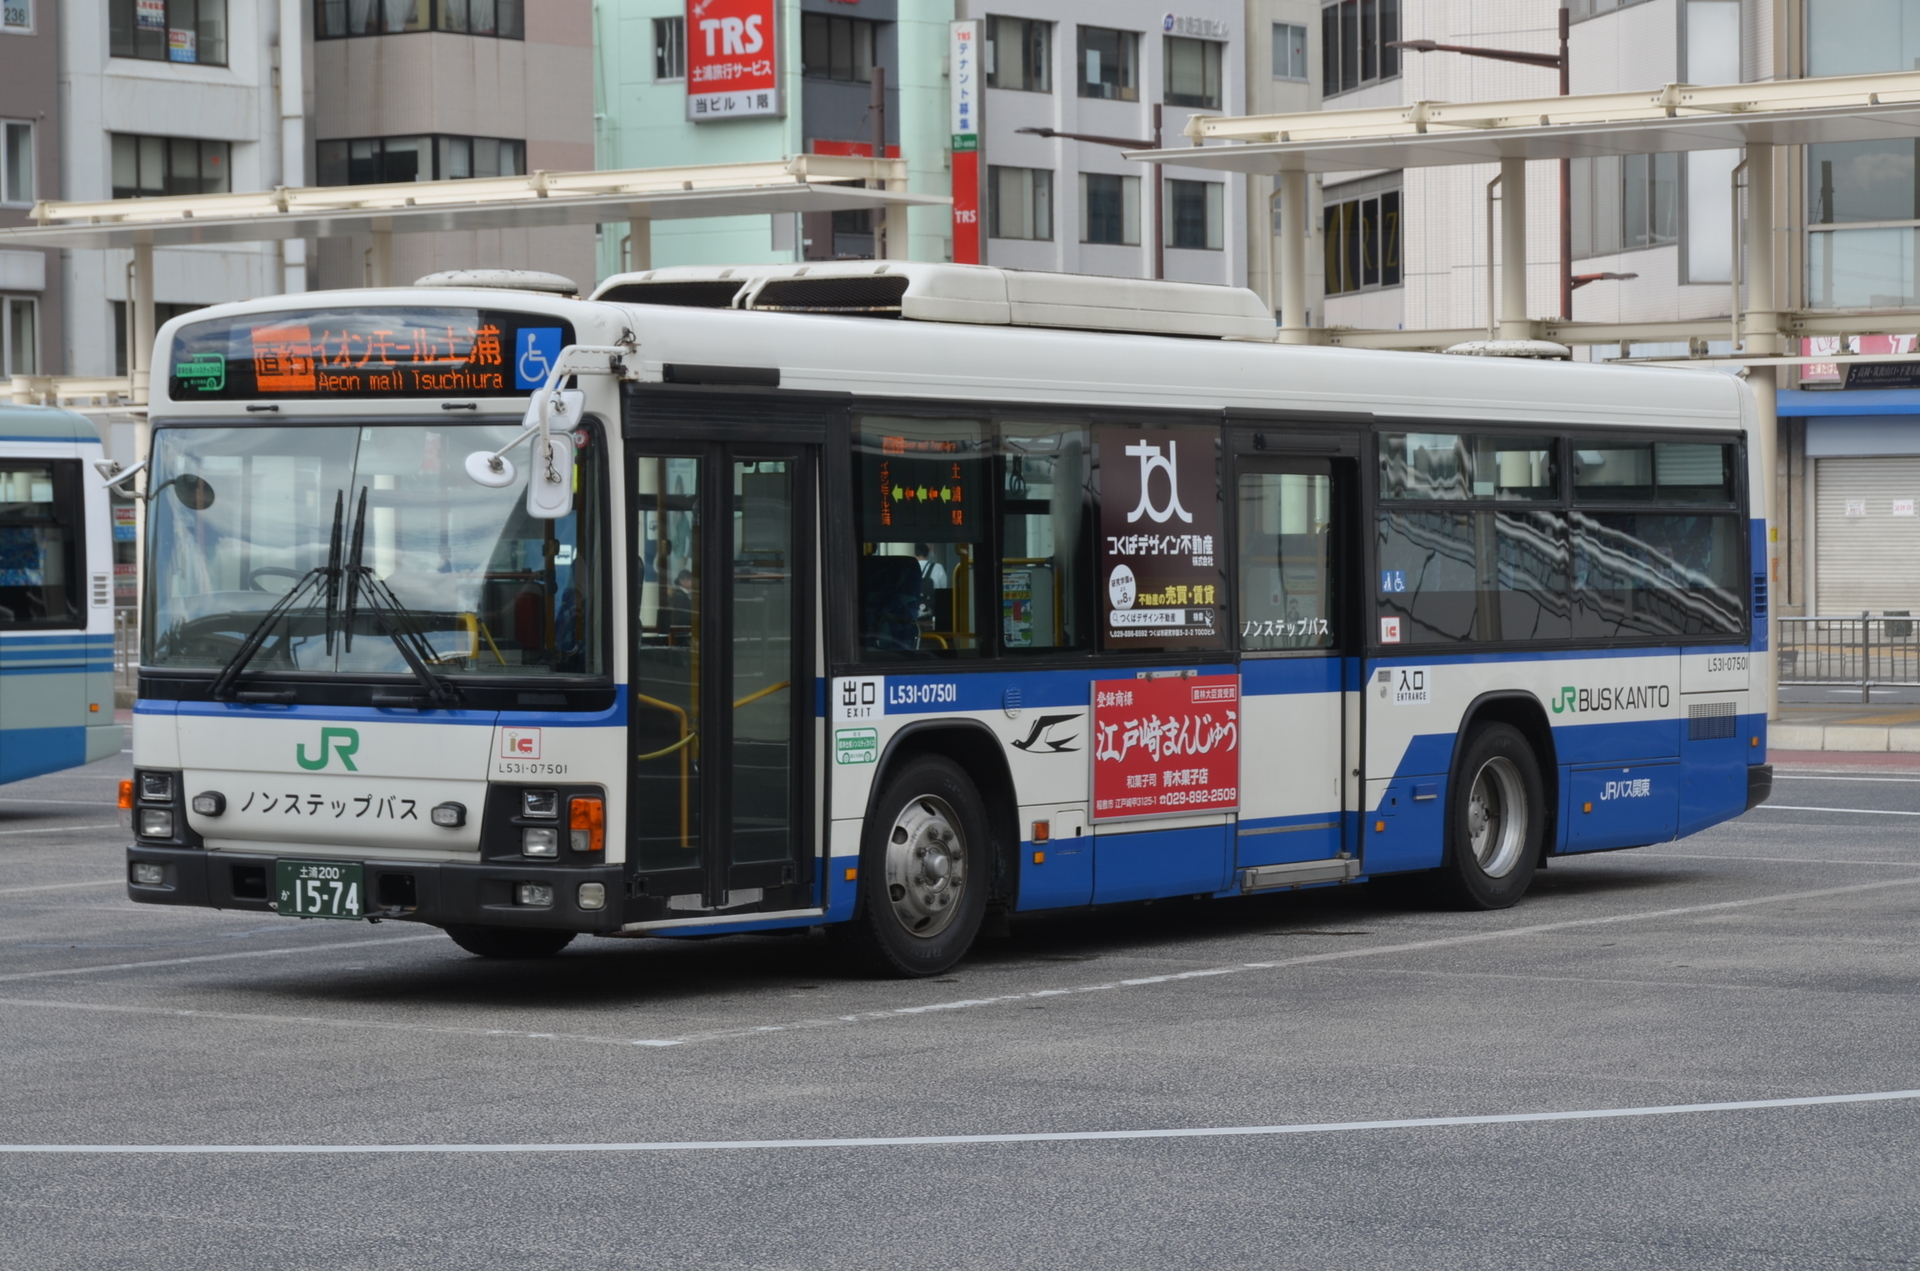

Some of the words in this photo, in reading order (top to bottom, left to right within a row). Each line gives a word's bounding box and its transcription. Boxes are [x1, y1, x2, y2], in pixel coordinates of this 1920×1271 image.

[5, 7, 25, 22] 236
[699, 14, 764, 57] TRS
[956, 31, 972, 41] TRS
[692, 60, 772, 82] 土浦旅行サービス
[959, 42, 970, 130] テナント募集
[696, 97, 735, 113] 当ビル
[746, 94, 769, 109] 1階
[955, 209, 976, 223] TRS
[313, 324, 502, 367] イオンモール土浦
[252, 338, 313, 378] 直行
[318, 372, 361, 392] Aeon
[369, 371, 404, 391] mall
[411, 370, 504, 391] Tsuchiura
[952, 462, 963, 525] 土浦駅
[1106, 534, 1214, 556] つくばデザイン不動産
[1192, 556, 1214, 567] 株式会社
[1119, 612, 1177, 623] つくばデザイン不動産
[1242, 617, 1329, 637] ノンステップバス
[1707, 656, 1748, 673] L531-07501
[1400, 670, 1424, 691] 入口
[843, 680, 876, 706] 出口
[889, 683, 957, 705] L531-07501
[1096, 690, 1134, 708] 登録商標
[1193, 688, 1236, 701] 農林大臣賞受賞
[1397, 692, 1427, 701] ENTRANCE
[1552, 686, 1577, 714] JR
[847, 707, 872, 718] EXIT
[296, 727, 360, 771] JR
[499, 762, 568, 775] L531-07501
[1126, 773, 1157, 789] 和菓子司
[1162, 768, 1209, 788] 青木菓子店
[1166, 787, 1237, 806] 029-892-2509
[1600, 778, 1651, 801] JRバス関東
[241, 791, 418, 820] ノンステップバス
[280, 889, 291, 901] か
[294, 878, 360, 916] 15-74
